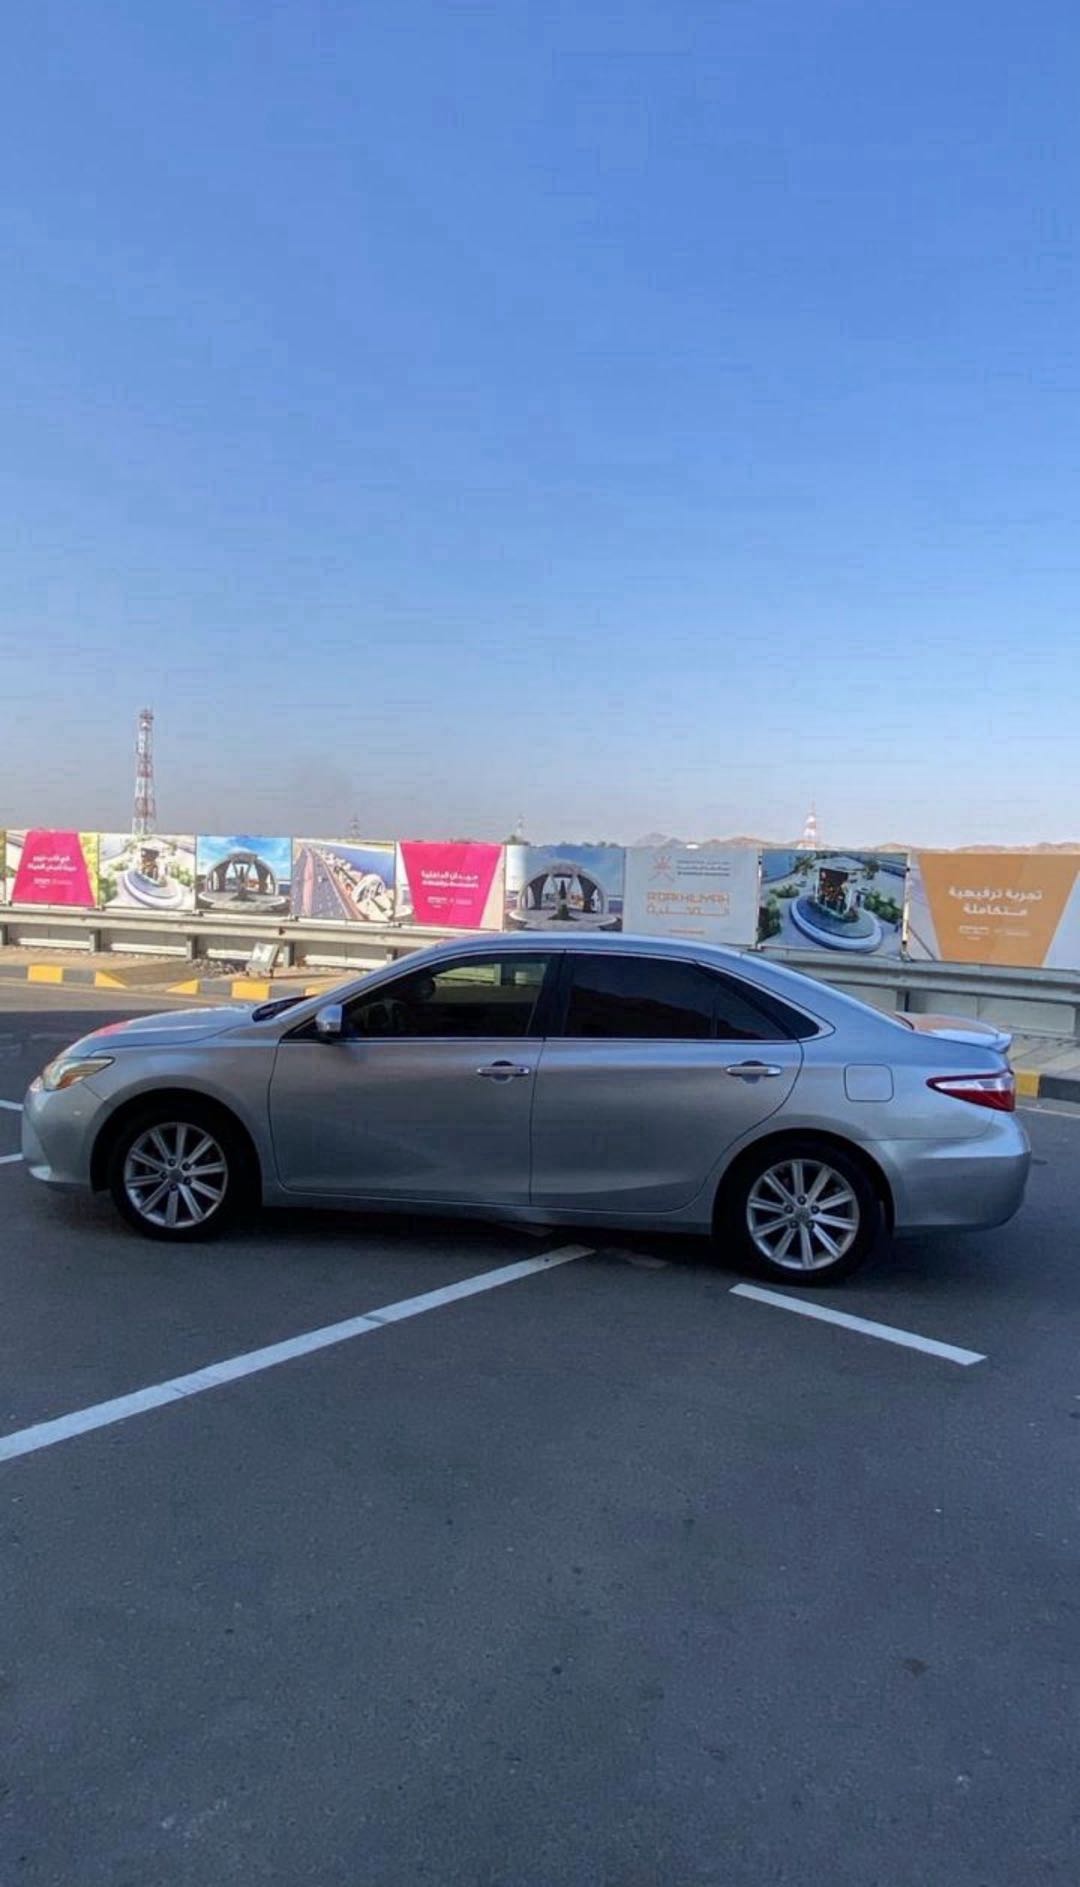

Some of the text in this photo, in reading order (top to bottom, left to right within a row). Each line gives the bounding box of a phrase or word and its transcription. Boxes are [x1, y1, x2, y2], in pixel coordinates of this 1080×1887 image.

[948, 885, 1042, 903] تجربة ترفيهية
[963, 903, 1028, 917] متكاملة
